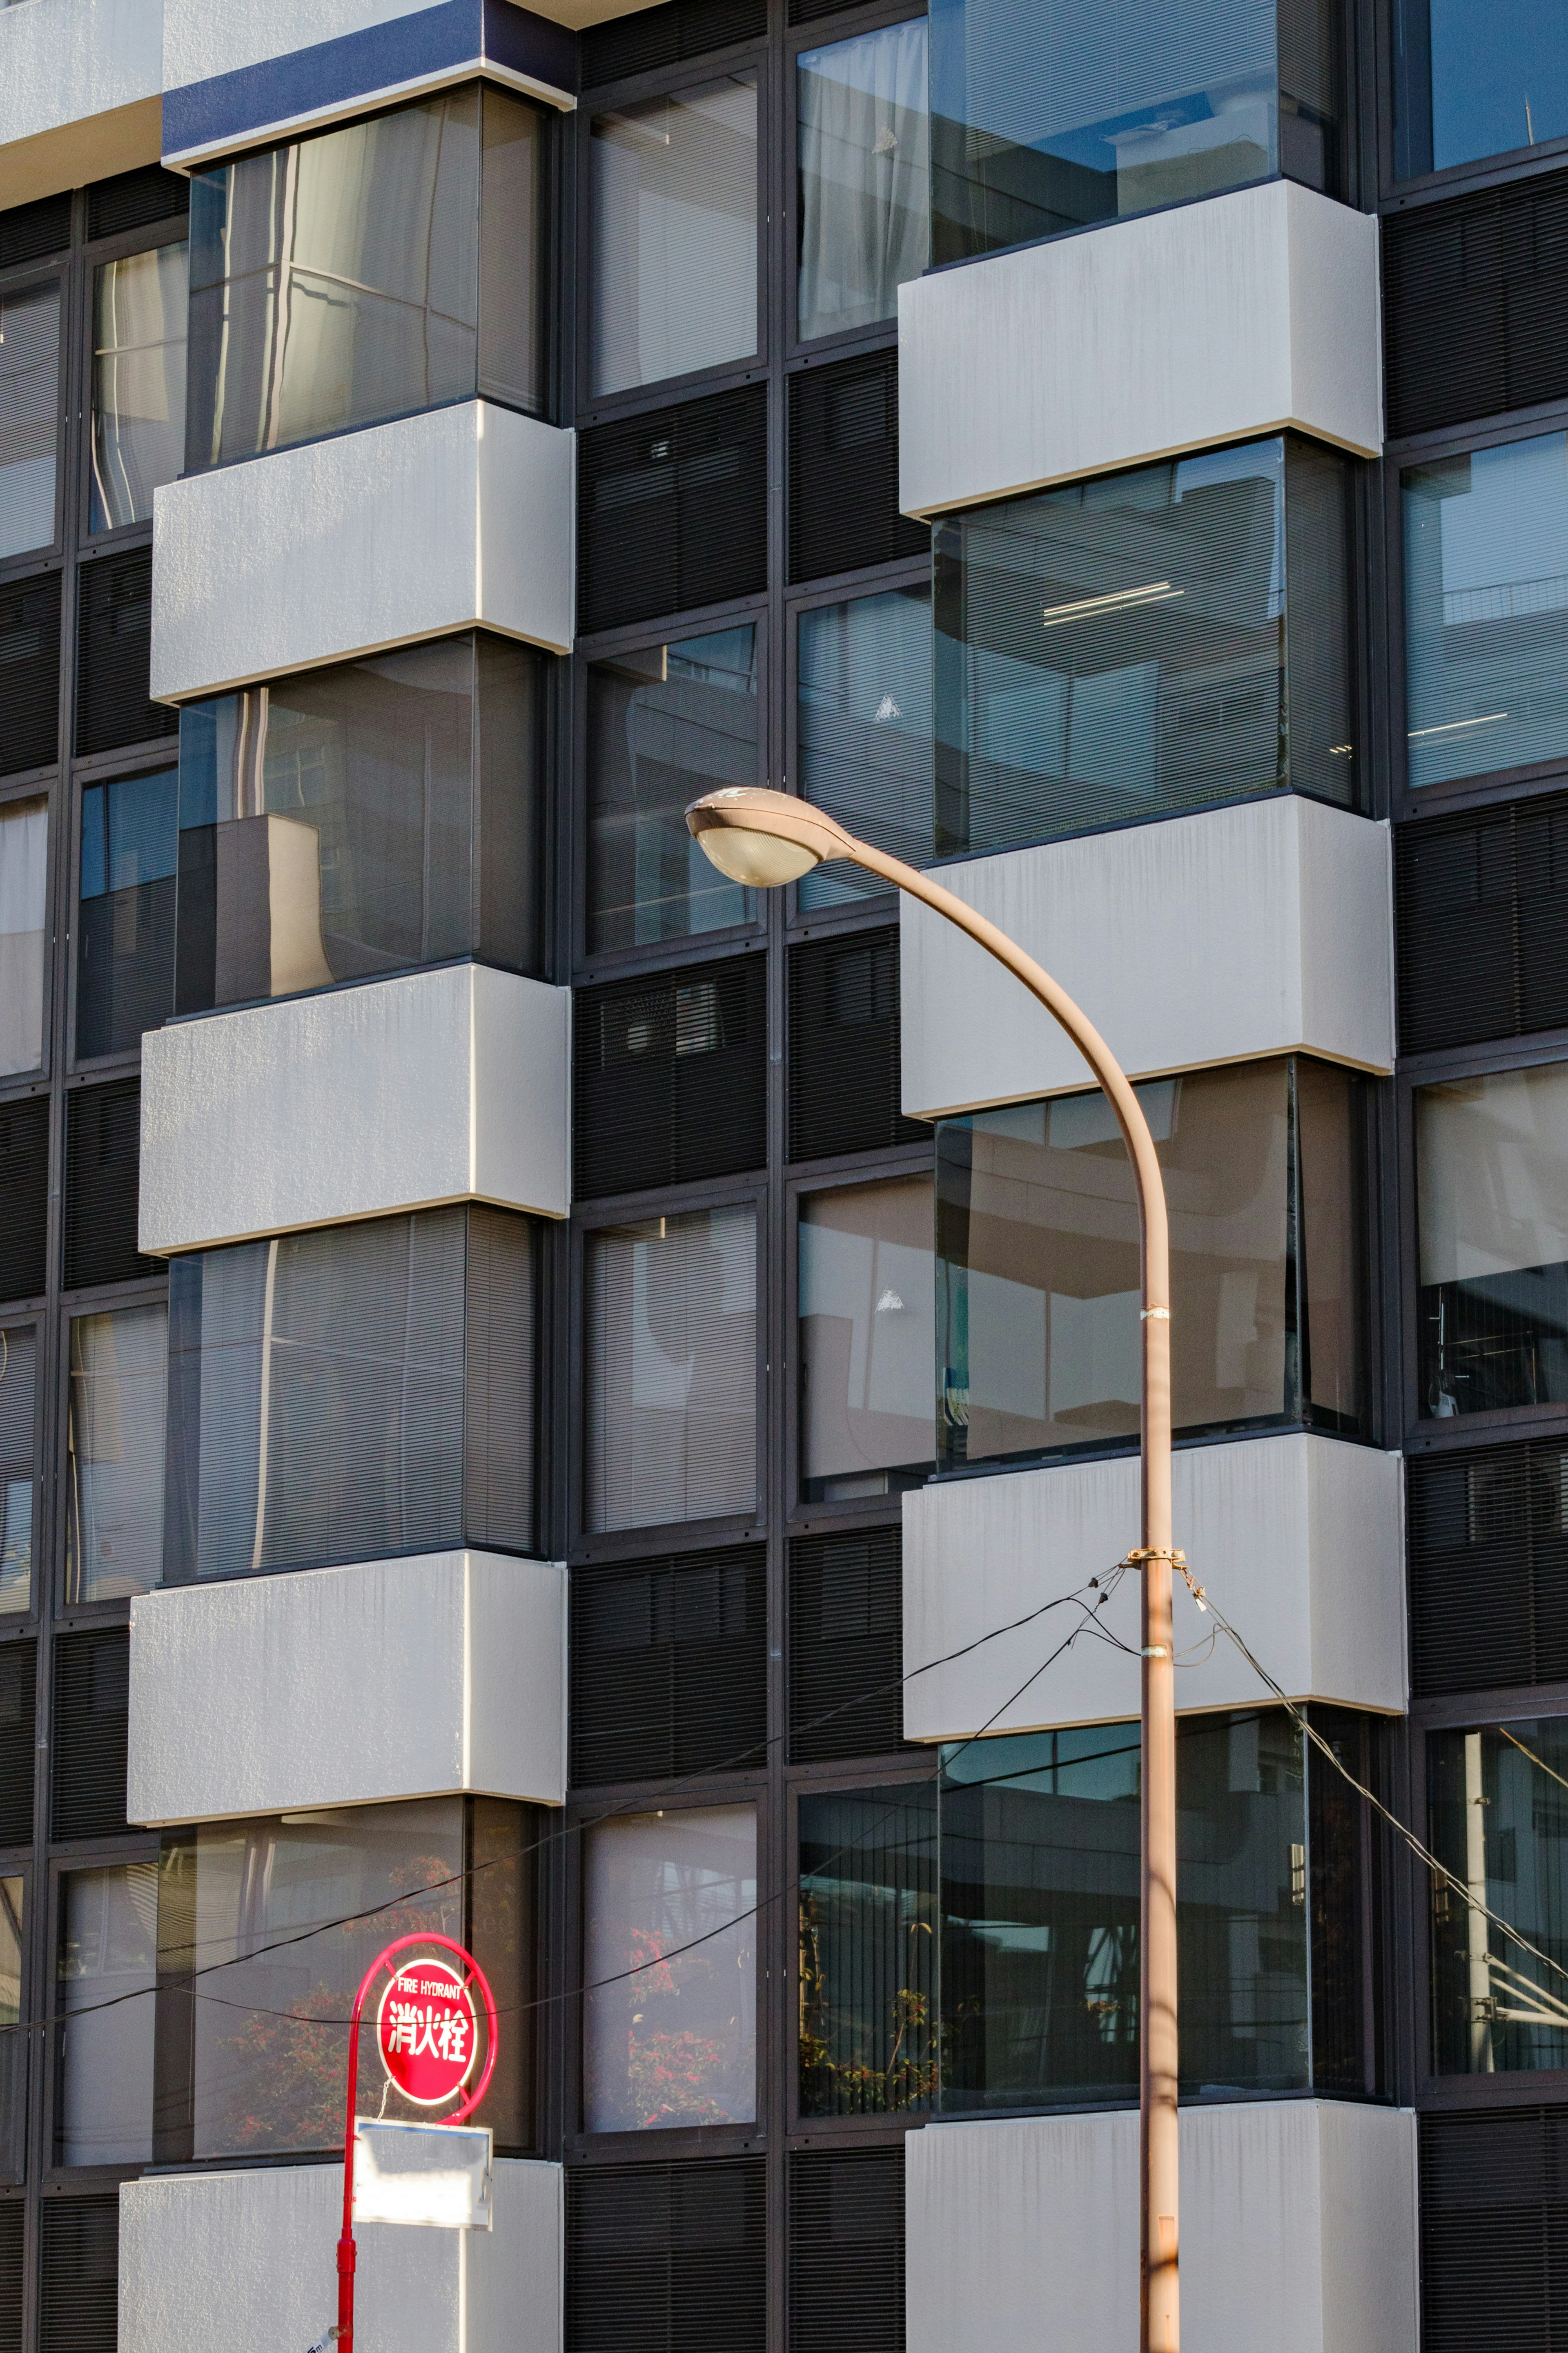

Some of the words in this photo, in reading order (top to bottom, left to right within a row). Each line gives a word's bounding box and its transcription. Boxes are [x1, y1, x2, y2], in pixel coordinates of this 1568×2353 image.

[398, 1976, 418, 1994] FIRE
[421, 1980, 461, 2000] HYDRANT
[388, 2001, 469, 2062] 消火栓
